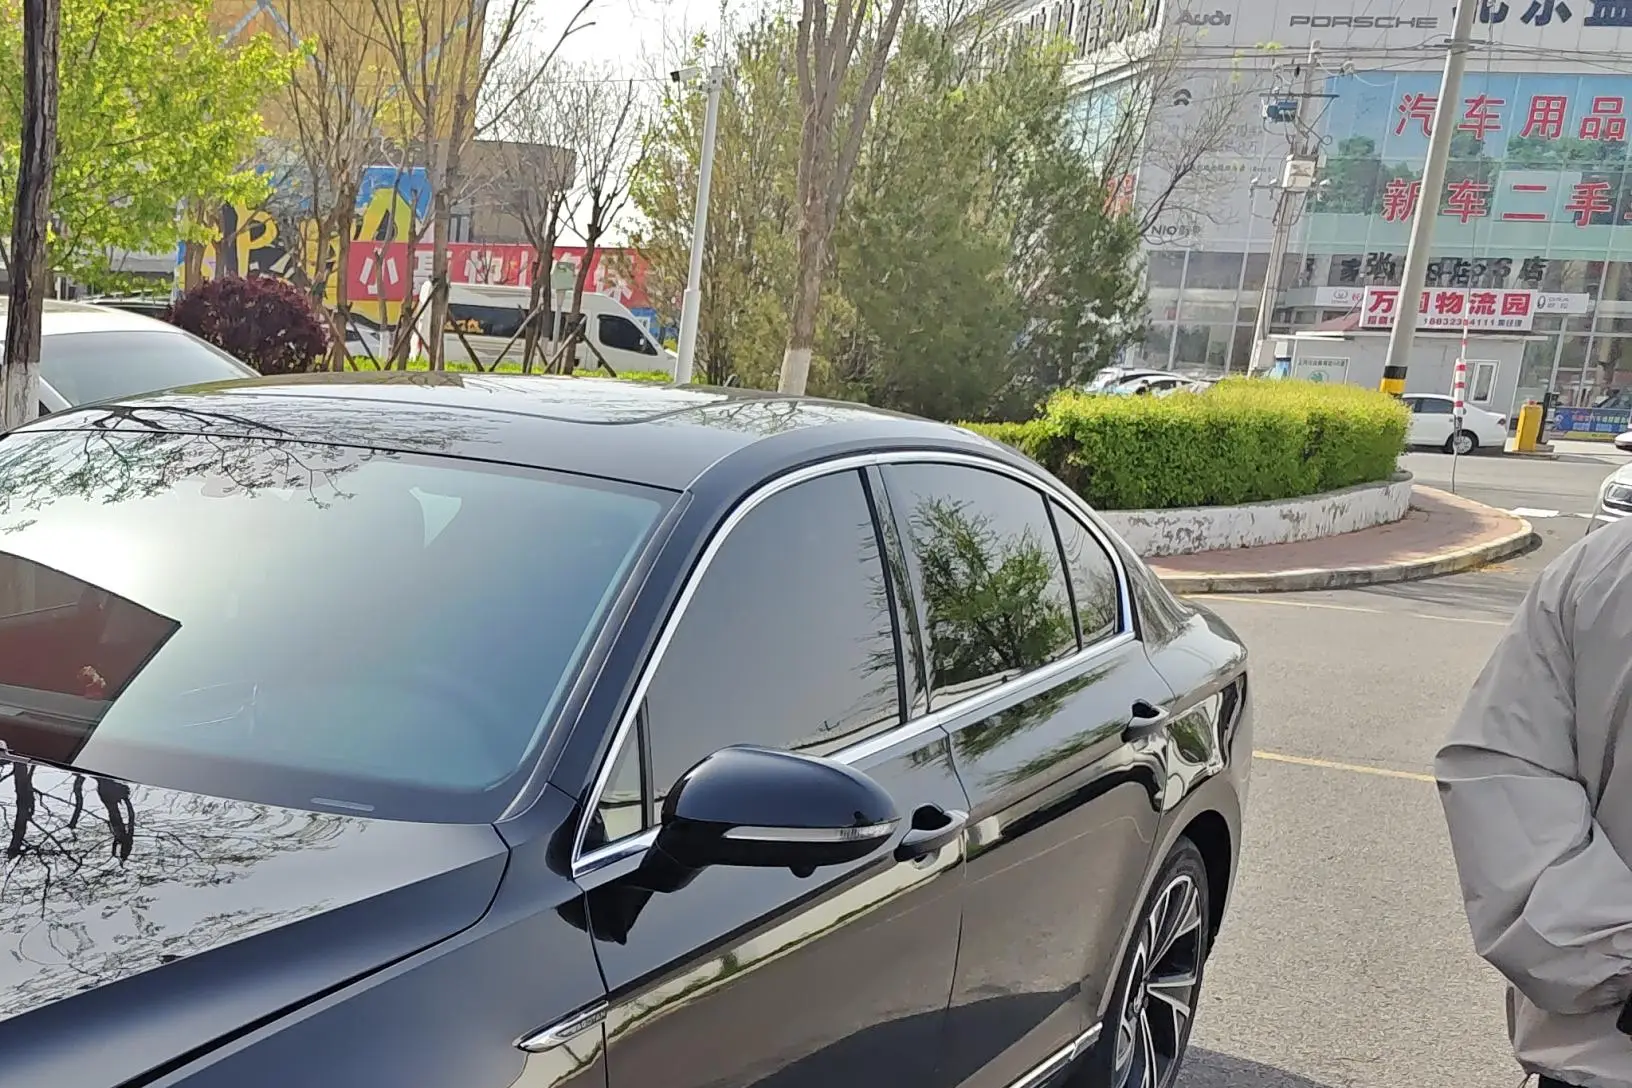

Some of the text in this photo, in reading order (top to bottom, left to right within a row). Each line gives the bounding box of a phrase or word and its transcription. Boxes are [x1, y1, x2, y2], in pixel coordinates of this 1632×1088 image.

[1175, 10, 1231, 26] Audi
[1289, 15, 1438, 29] PORSCHE
[1393, 92, 1628, 141] 汽车用品
[1381, 178, 1632, 229] 新车二手
[1151, 225, 1177, 236] NIO
[1368, 291, 1532, 317] 万物流园
